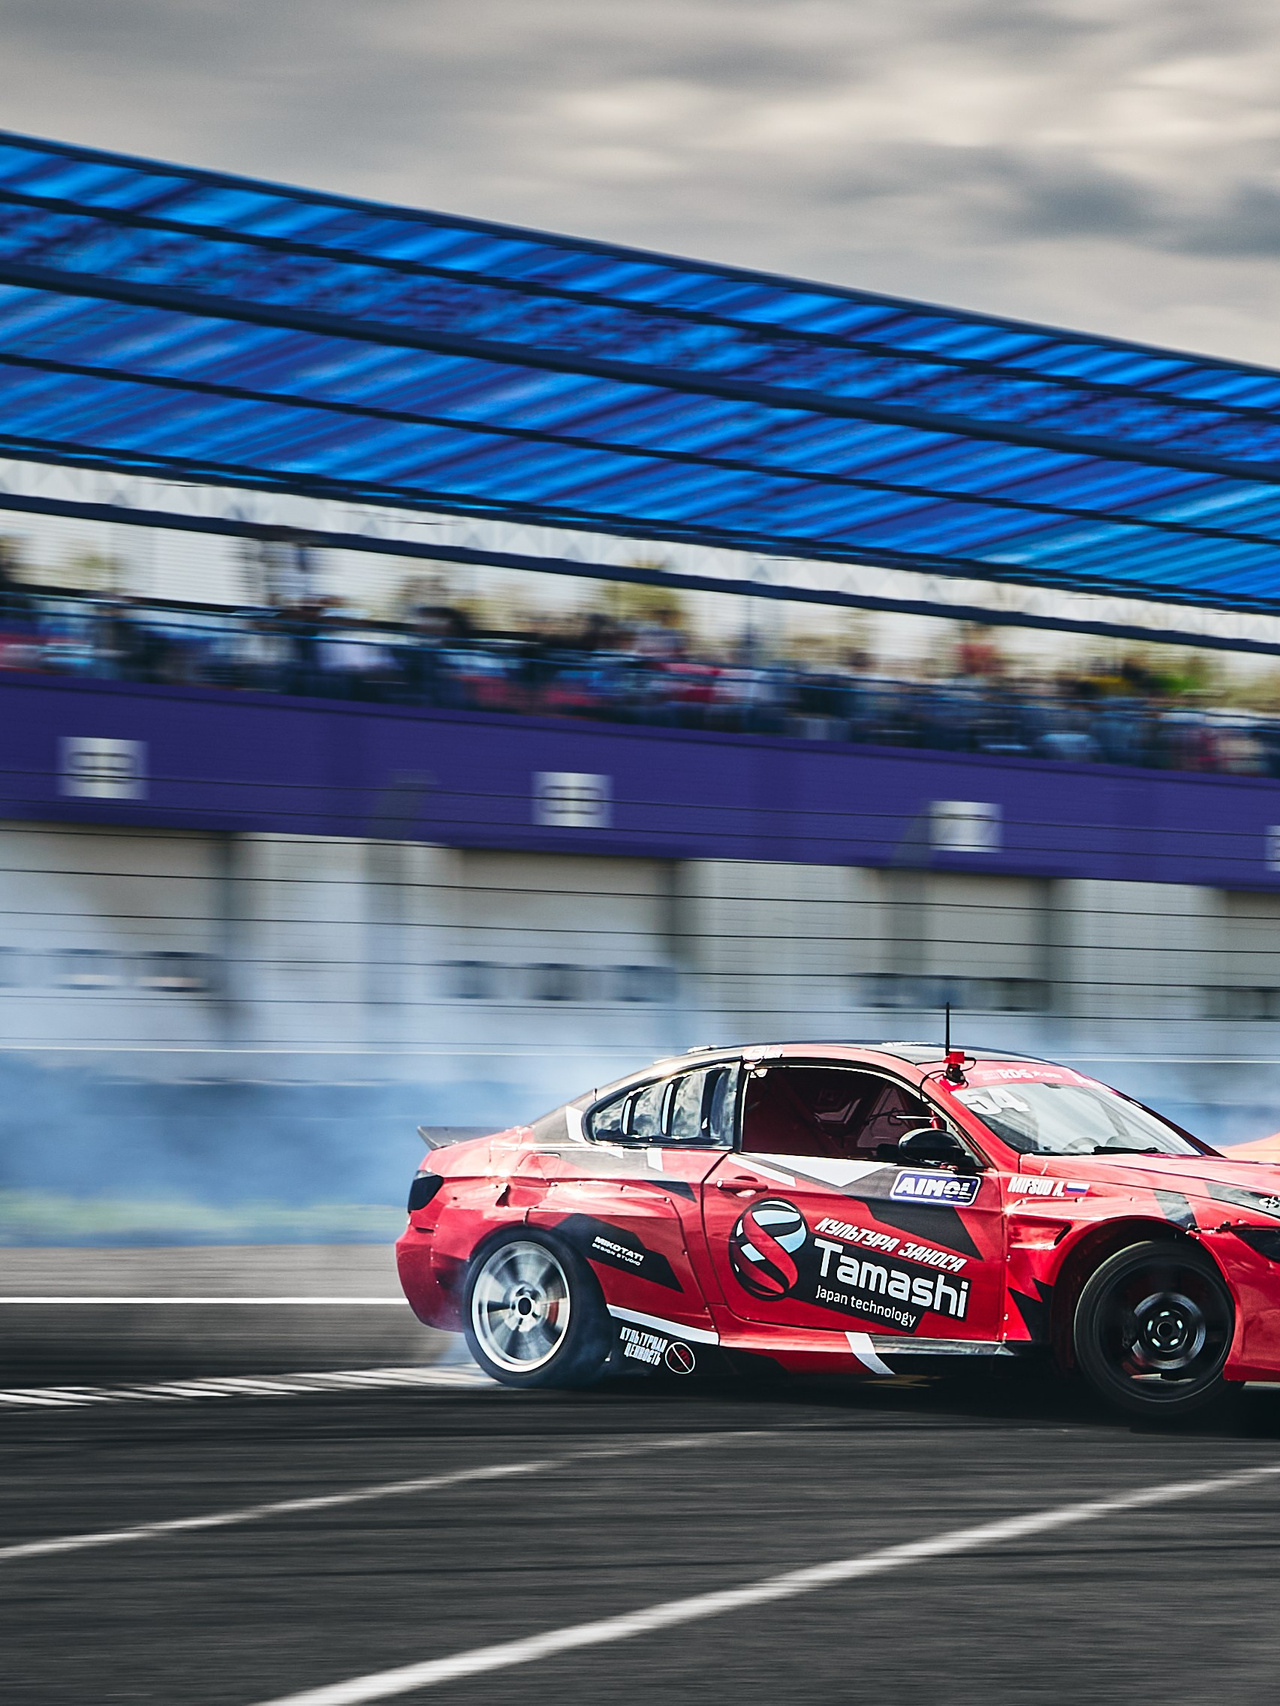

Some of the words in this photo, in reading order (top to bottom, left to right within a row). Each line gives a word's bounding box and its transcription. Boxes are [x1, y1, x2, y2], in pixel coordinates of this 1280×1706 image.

[950, 1088, 1031, 1115] 54
[895, 1176, 973, 1201] AIMOL
[1007, 1176, 1054, 1196] MIFSUD
[814, 1217, 901, 1253] КУЛЬТУРА
[897, 1242, 968, 1273] ЗАНОСА
[813, 1237, 970, 1319] Tamashi
[815, 1284, 849, 1306] Japan
[850, 1295, 917, 1328] technology
